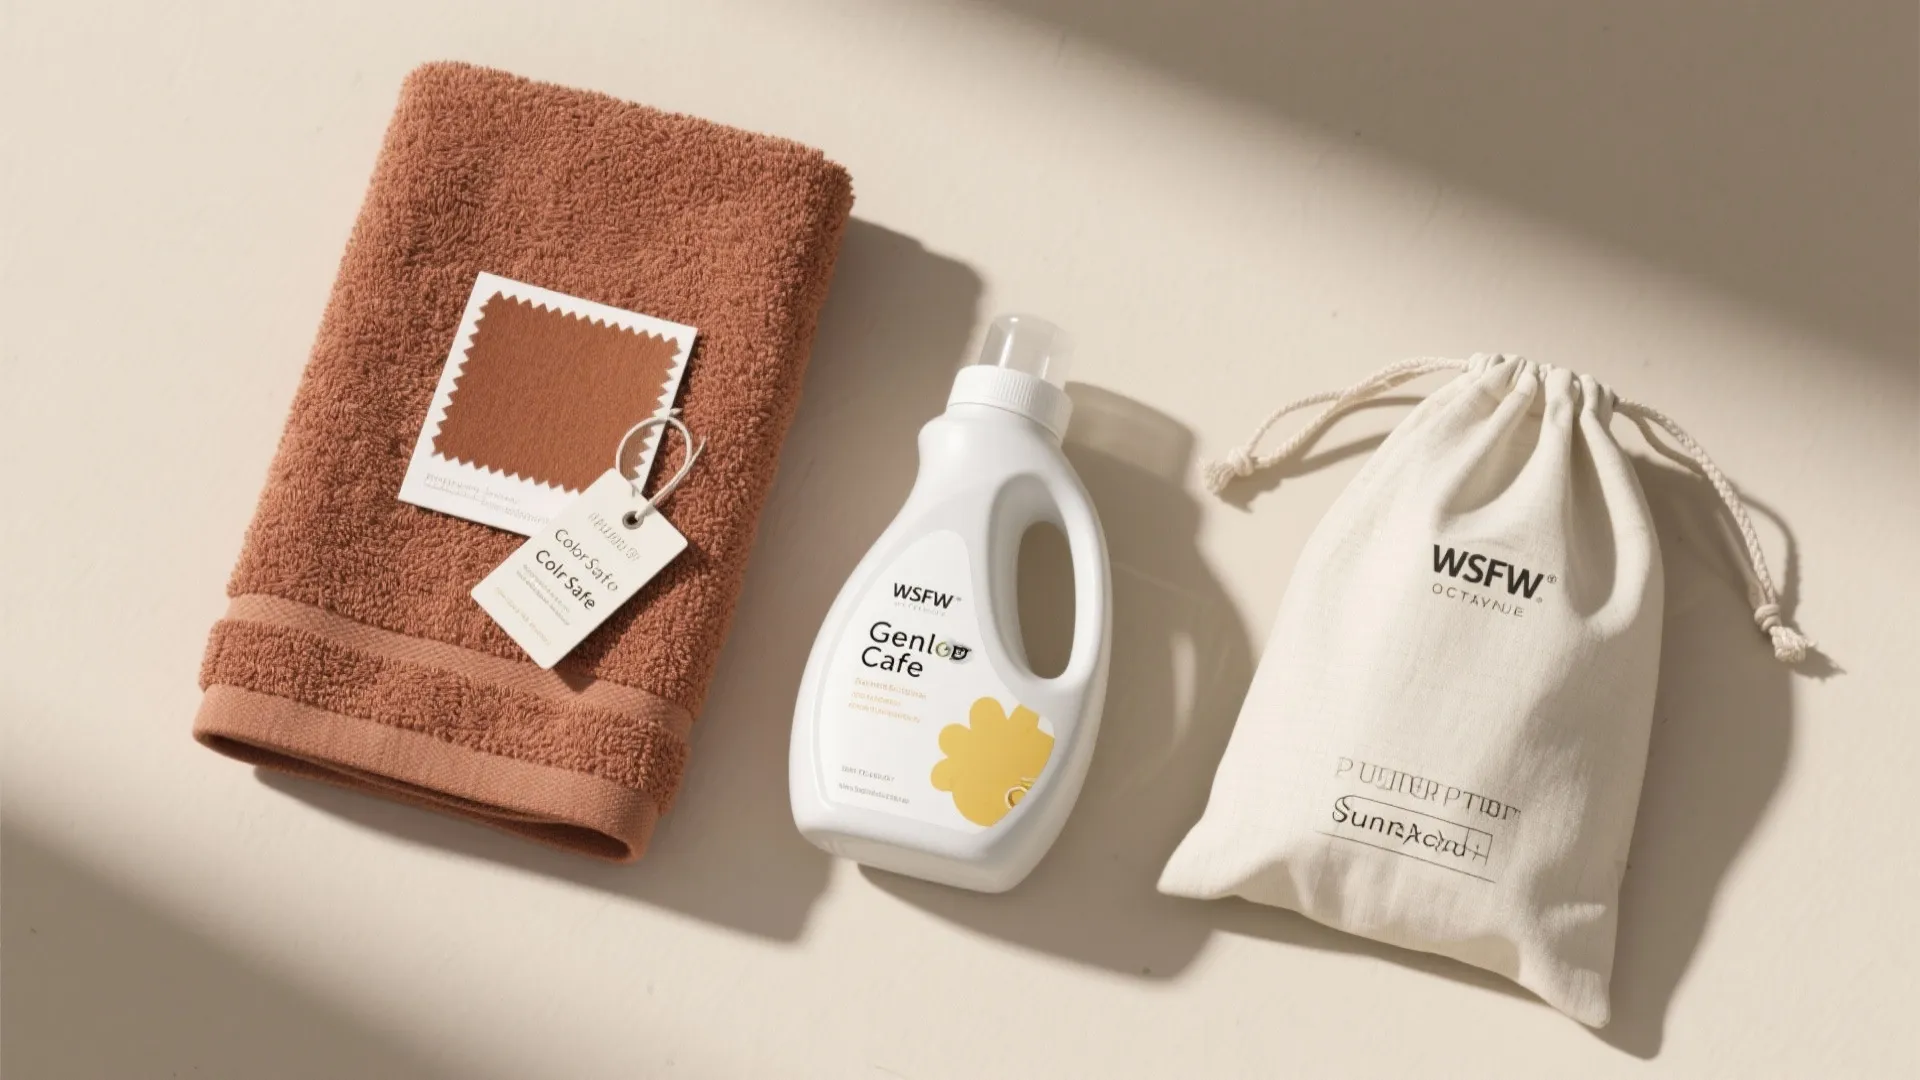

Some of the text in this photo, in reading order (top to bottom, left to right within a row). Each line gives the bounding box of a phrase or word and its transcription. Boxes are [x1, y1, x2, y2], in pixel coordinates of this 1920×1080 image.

[1433, 544, 1545, 599] WSFW
[564, 576, 595, 610] Safe
[893, 582, 954, 609] WSFW
[861, 646, 923, 677] Cafe
